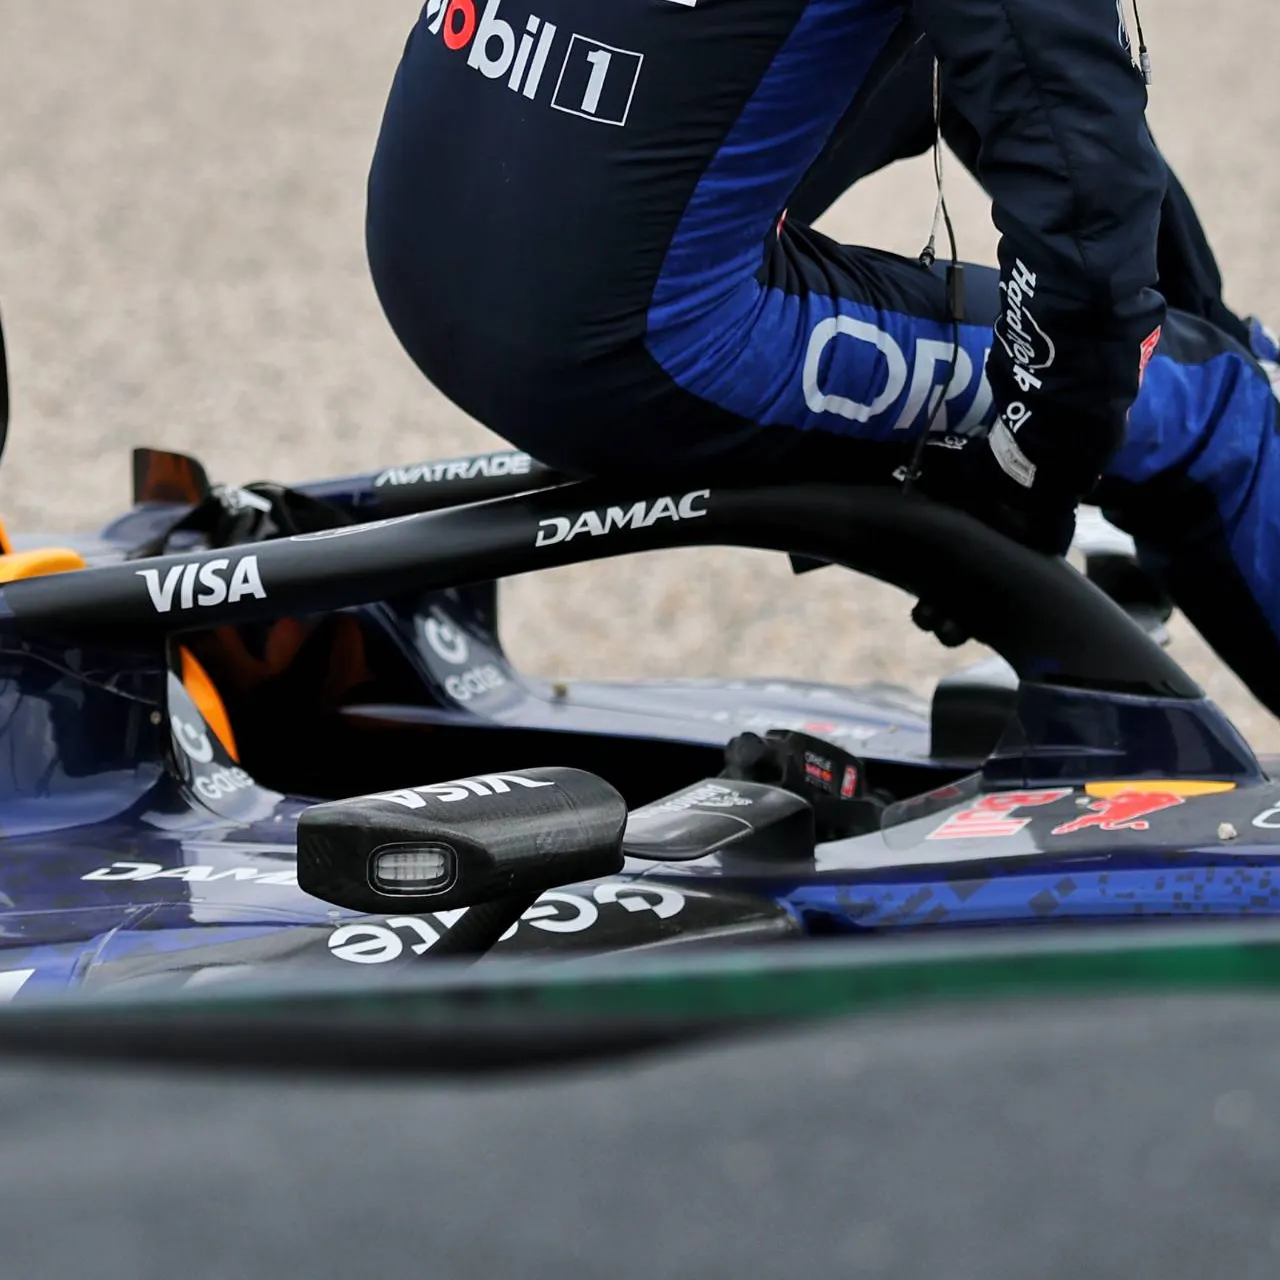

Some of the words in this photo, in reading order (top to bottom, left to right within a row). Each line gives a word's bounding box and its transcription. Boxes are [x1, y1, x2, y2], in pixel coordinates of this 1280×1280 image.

[374, 452, 532, 488] AVATRADE
[535, 489, 711, 548] DAMAC
[135, 555, 268, 613] VISA
[444, 664, 506, 701] Gate
[194, 766, 255, 799] Gate
[371, 773, 556, 811] VISA
